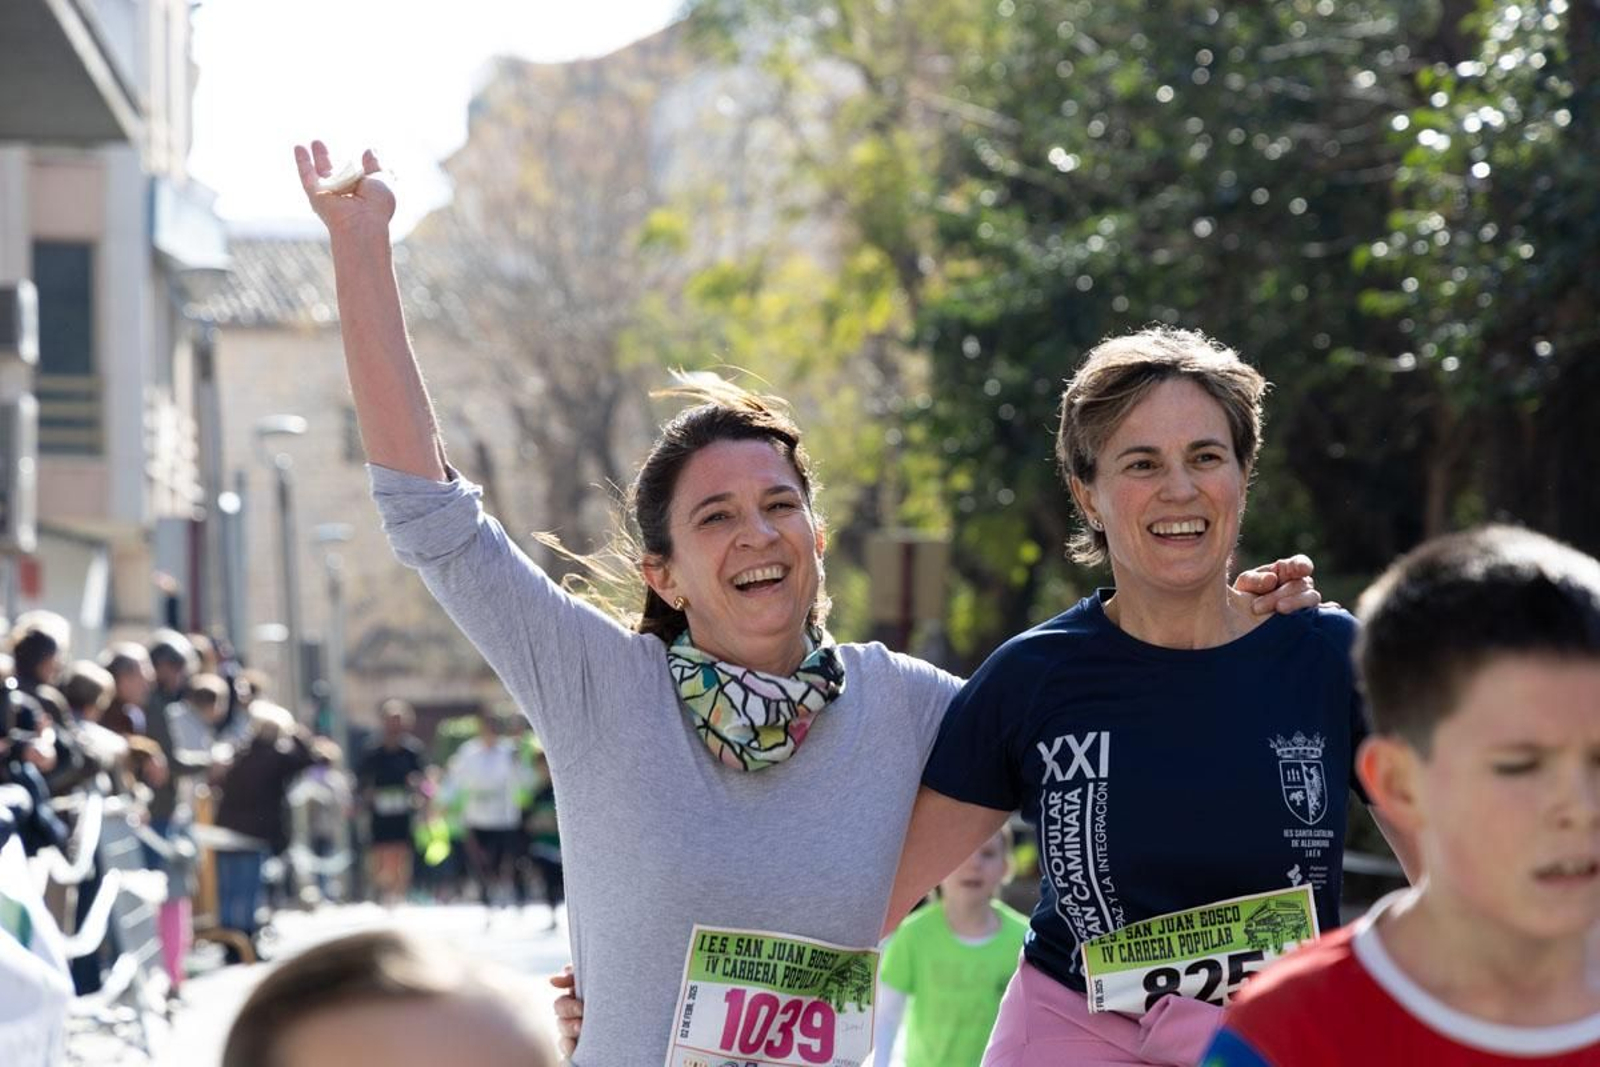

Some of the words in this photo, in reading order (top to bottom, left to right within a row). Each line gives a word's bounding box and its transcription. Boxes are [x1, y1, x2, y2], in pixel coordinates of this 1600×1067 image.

[1036, 731, 1110, 785] XXI
[1048, 791, 1069, 888] POPULAR
[1063, 787, 1091, 901] CAMINATA
[1094, 782, 1110, 872] INTEGRACIÓN
[1101, 875, 1116, 893] LA
[1107, 896, 1119, 904] Y
[1081, 906, 1105, 940] AN
[1125, 921, 1153, 940] SAN
[1158, 913, 1195, 934] JUAN
[1199, 905, 1241, 928] BOSCO
[735, 938, 763, 959] SAN
[768, 941, 806, 965] JUAN
[1101, 945, 1114, 963] IV
[1118, 937, 1176, 963] CARRERA
[1179, 927, 1233, 956] POPULAR
[705, 955, 720, 974] IV
[722, 959, 779, 986] CARRERA
[719, 987, 836, 1064] 1039
